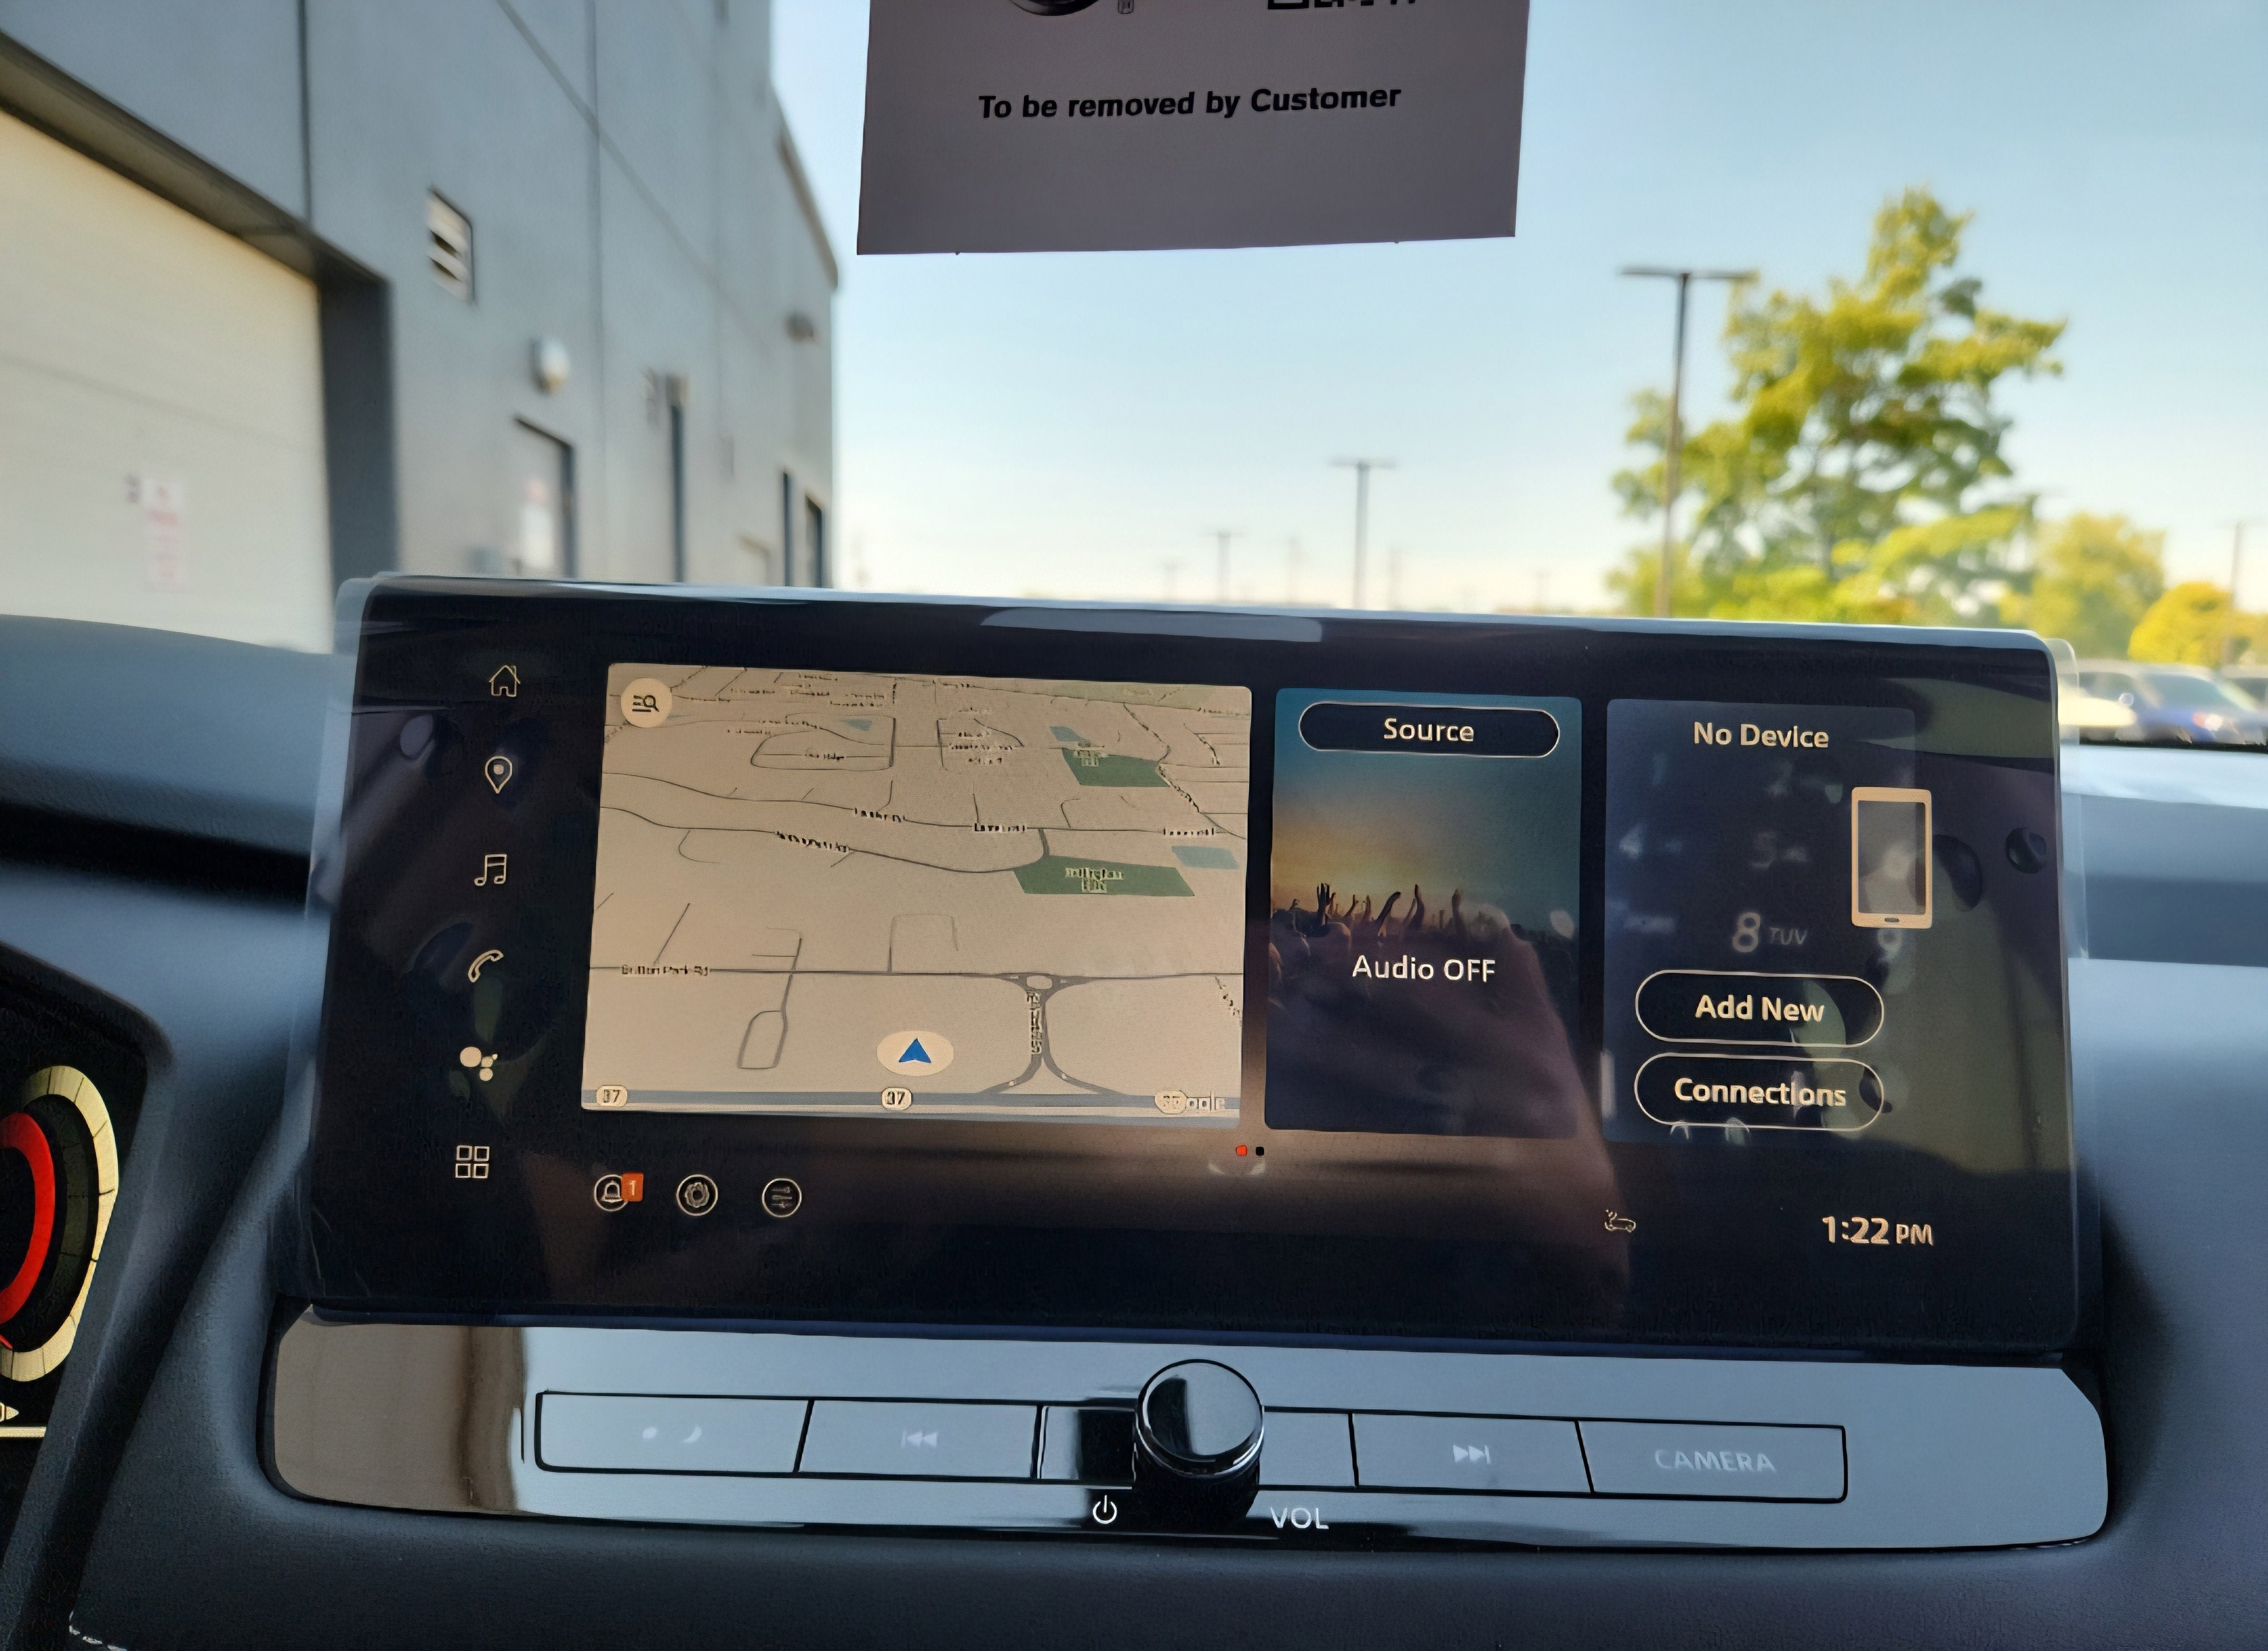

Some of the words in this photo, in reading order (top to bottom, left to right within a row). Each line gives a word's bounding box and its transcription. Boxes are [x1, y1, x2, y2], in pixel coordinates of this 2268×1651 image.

[979, 95, 1012, 119] To
[1022, 95, 1057, 118] be
[1068, 91, 1195, 117] removed
[1205, 90, 1242, 119] by
[1251, 87, 1402, 112] Customer
[1383, 717, 1475, 742] Source
[1694, 722, 1732, 745] No
[1740, 724, 1830, 748] Device
[1352, 955, 1434, 980] Audio
[1444, 959, 1496, 983] OFF
[1695, 994, 1753, 1020] Add
[1762, 997, 1825, 1023] New
[1674, 1078, 1847, 1107] Connections
[1822, 1216, 1890, 1245] 1:22
[1896, 1223, 1934, 1246] PM
[1654, 1448, 1777, 1474] CAMERA
[1270, 1506, 1329, 1530] VOL
